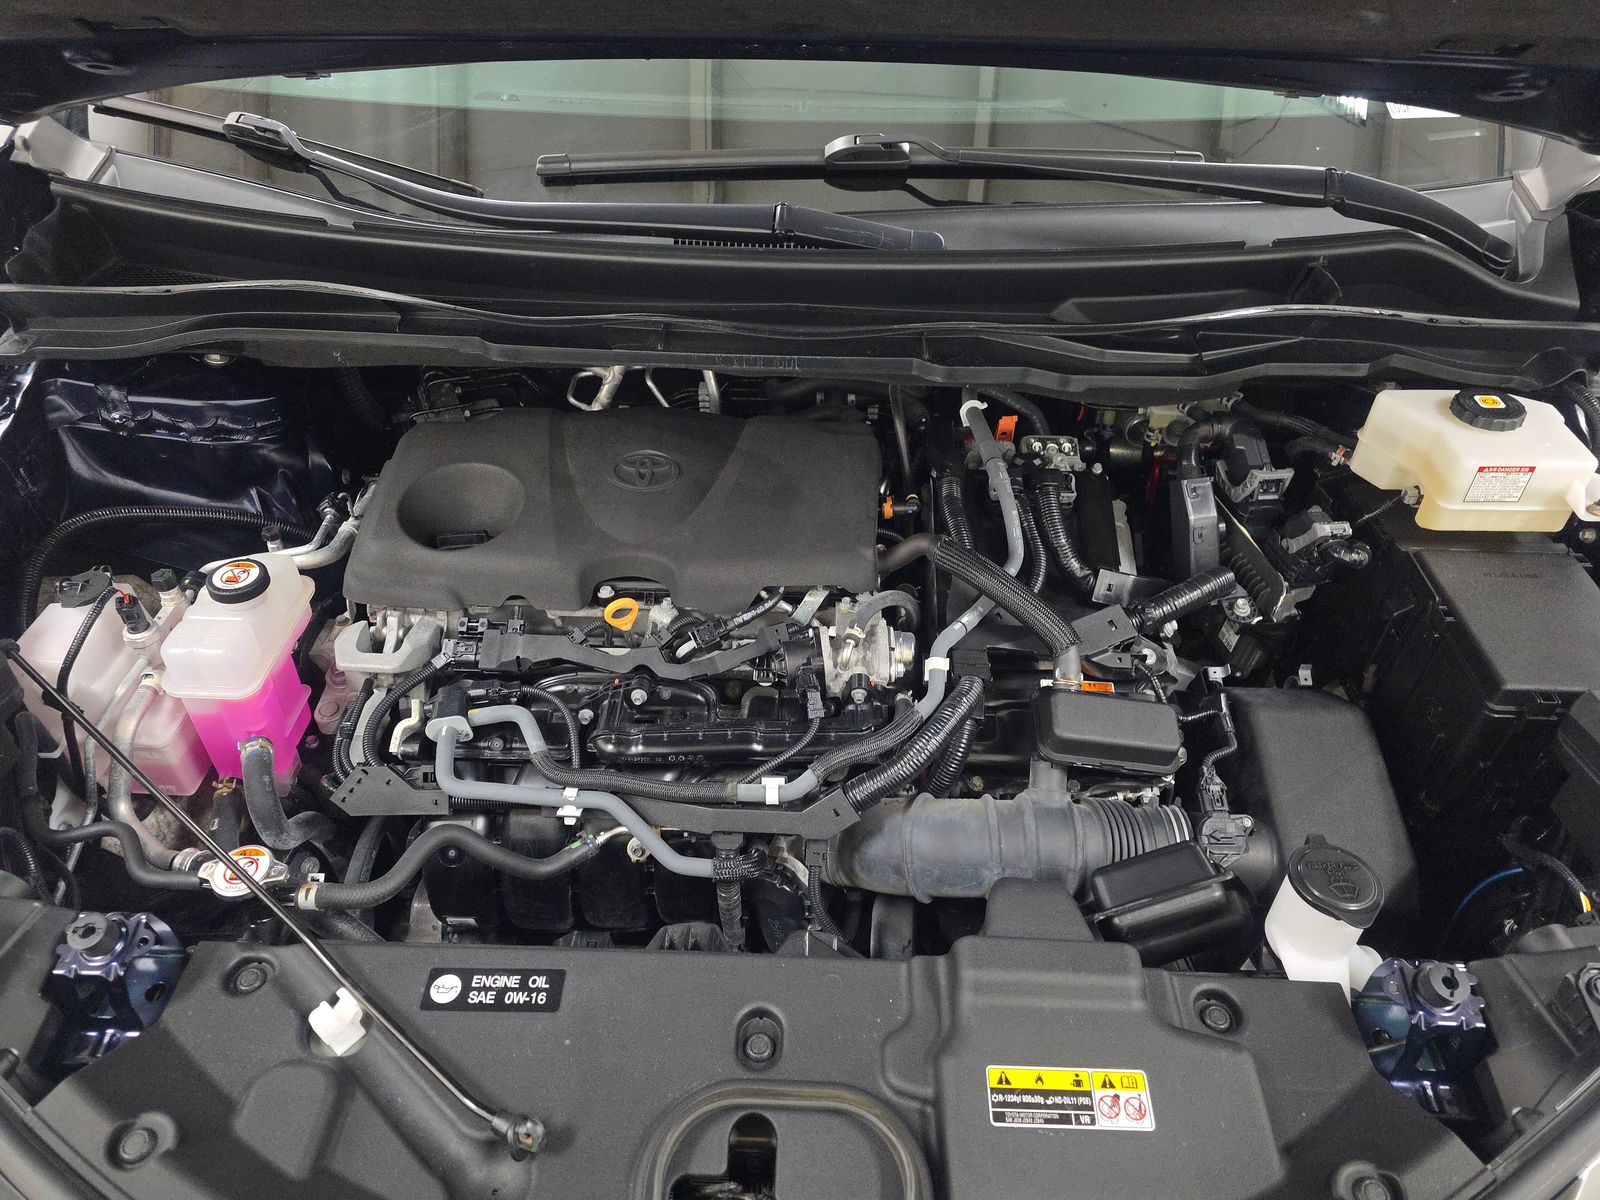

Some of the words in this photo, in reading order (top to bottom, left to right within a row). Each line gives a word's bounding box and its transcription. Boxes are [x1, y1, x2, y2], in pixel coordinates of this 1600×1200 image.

[471, 975, 521, 988] ENGINE
[528, 976, 550, 988] OIL
[467, 991, 496, 1004] SAE
[504, 992, 547, 1004] 0W-16
[1079, 1114, 1091, 1124] VR
